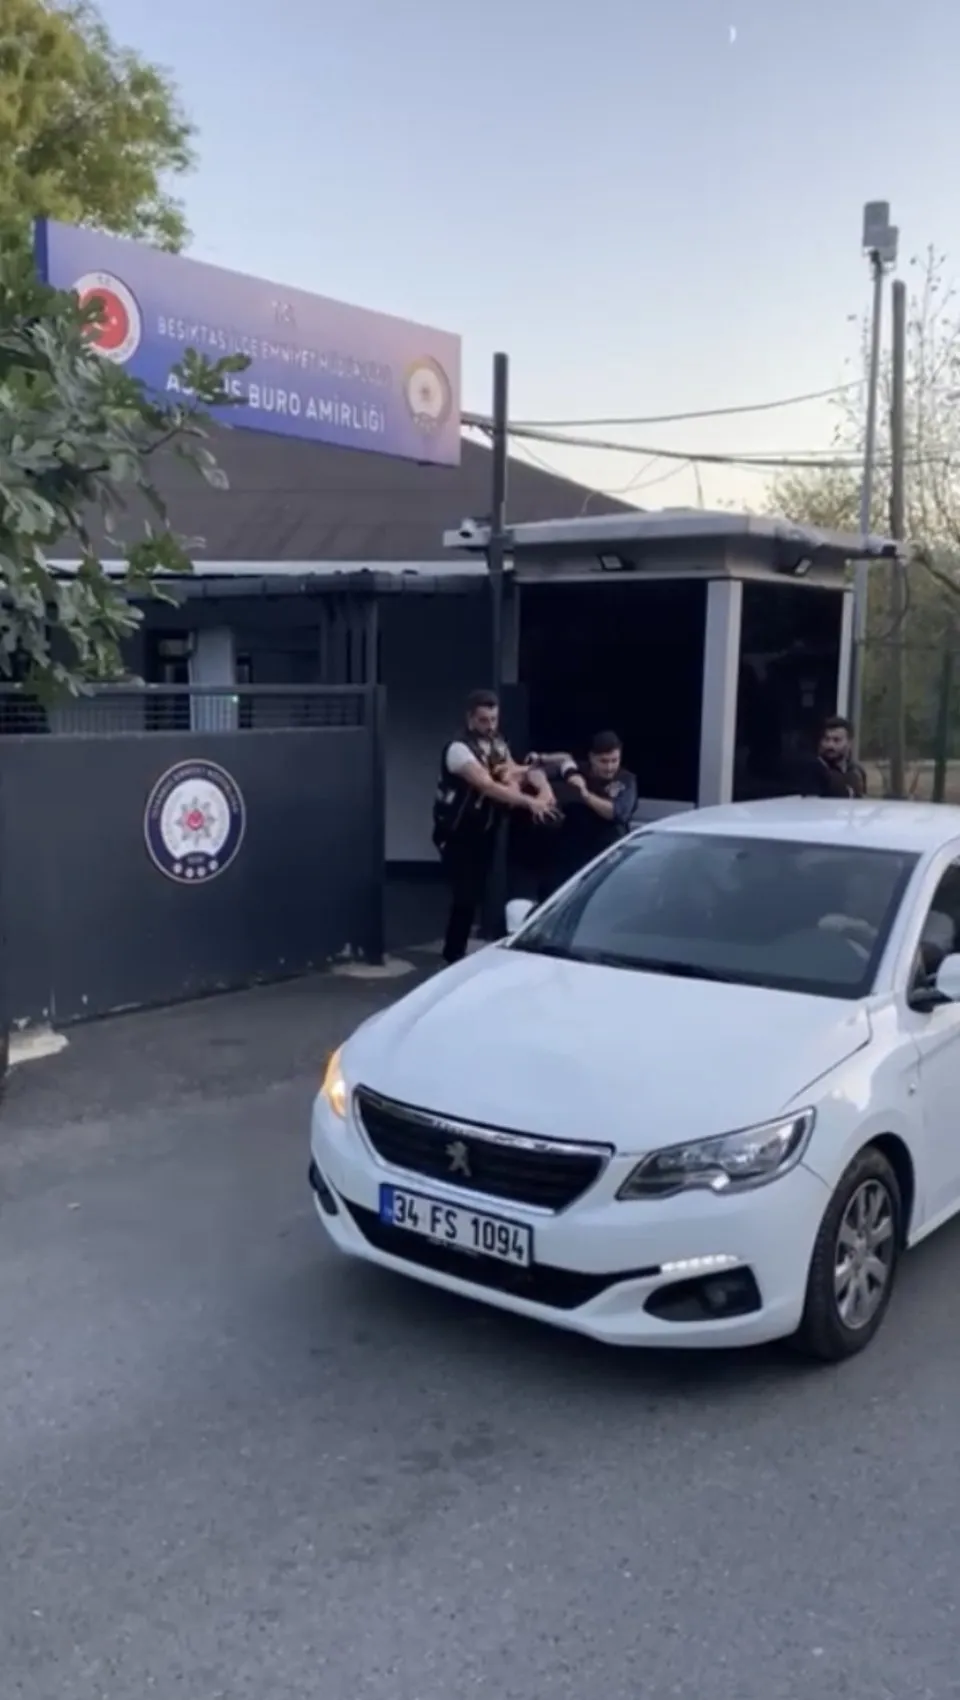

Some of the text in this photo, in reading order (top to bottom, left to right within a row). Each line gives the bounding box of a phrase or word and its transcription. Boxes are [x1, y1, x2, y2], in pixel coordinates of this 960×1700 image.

[395, 1196, 419, 1228] 34
[430, 1205, 458, 1240] FS
[471, 1217, 525, 1261] 1094
